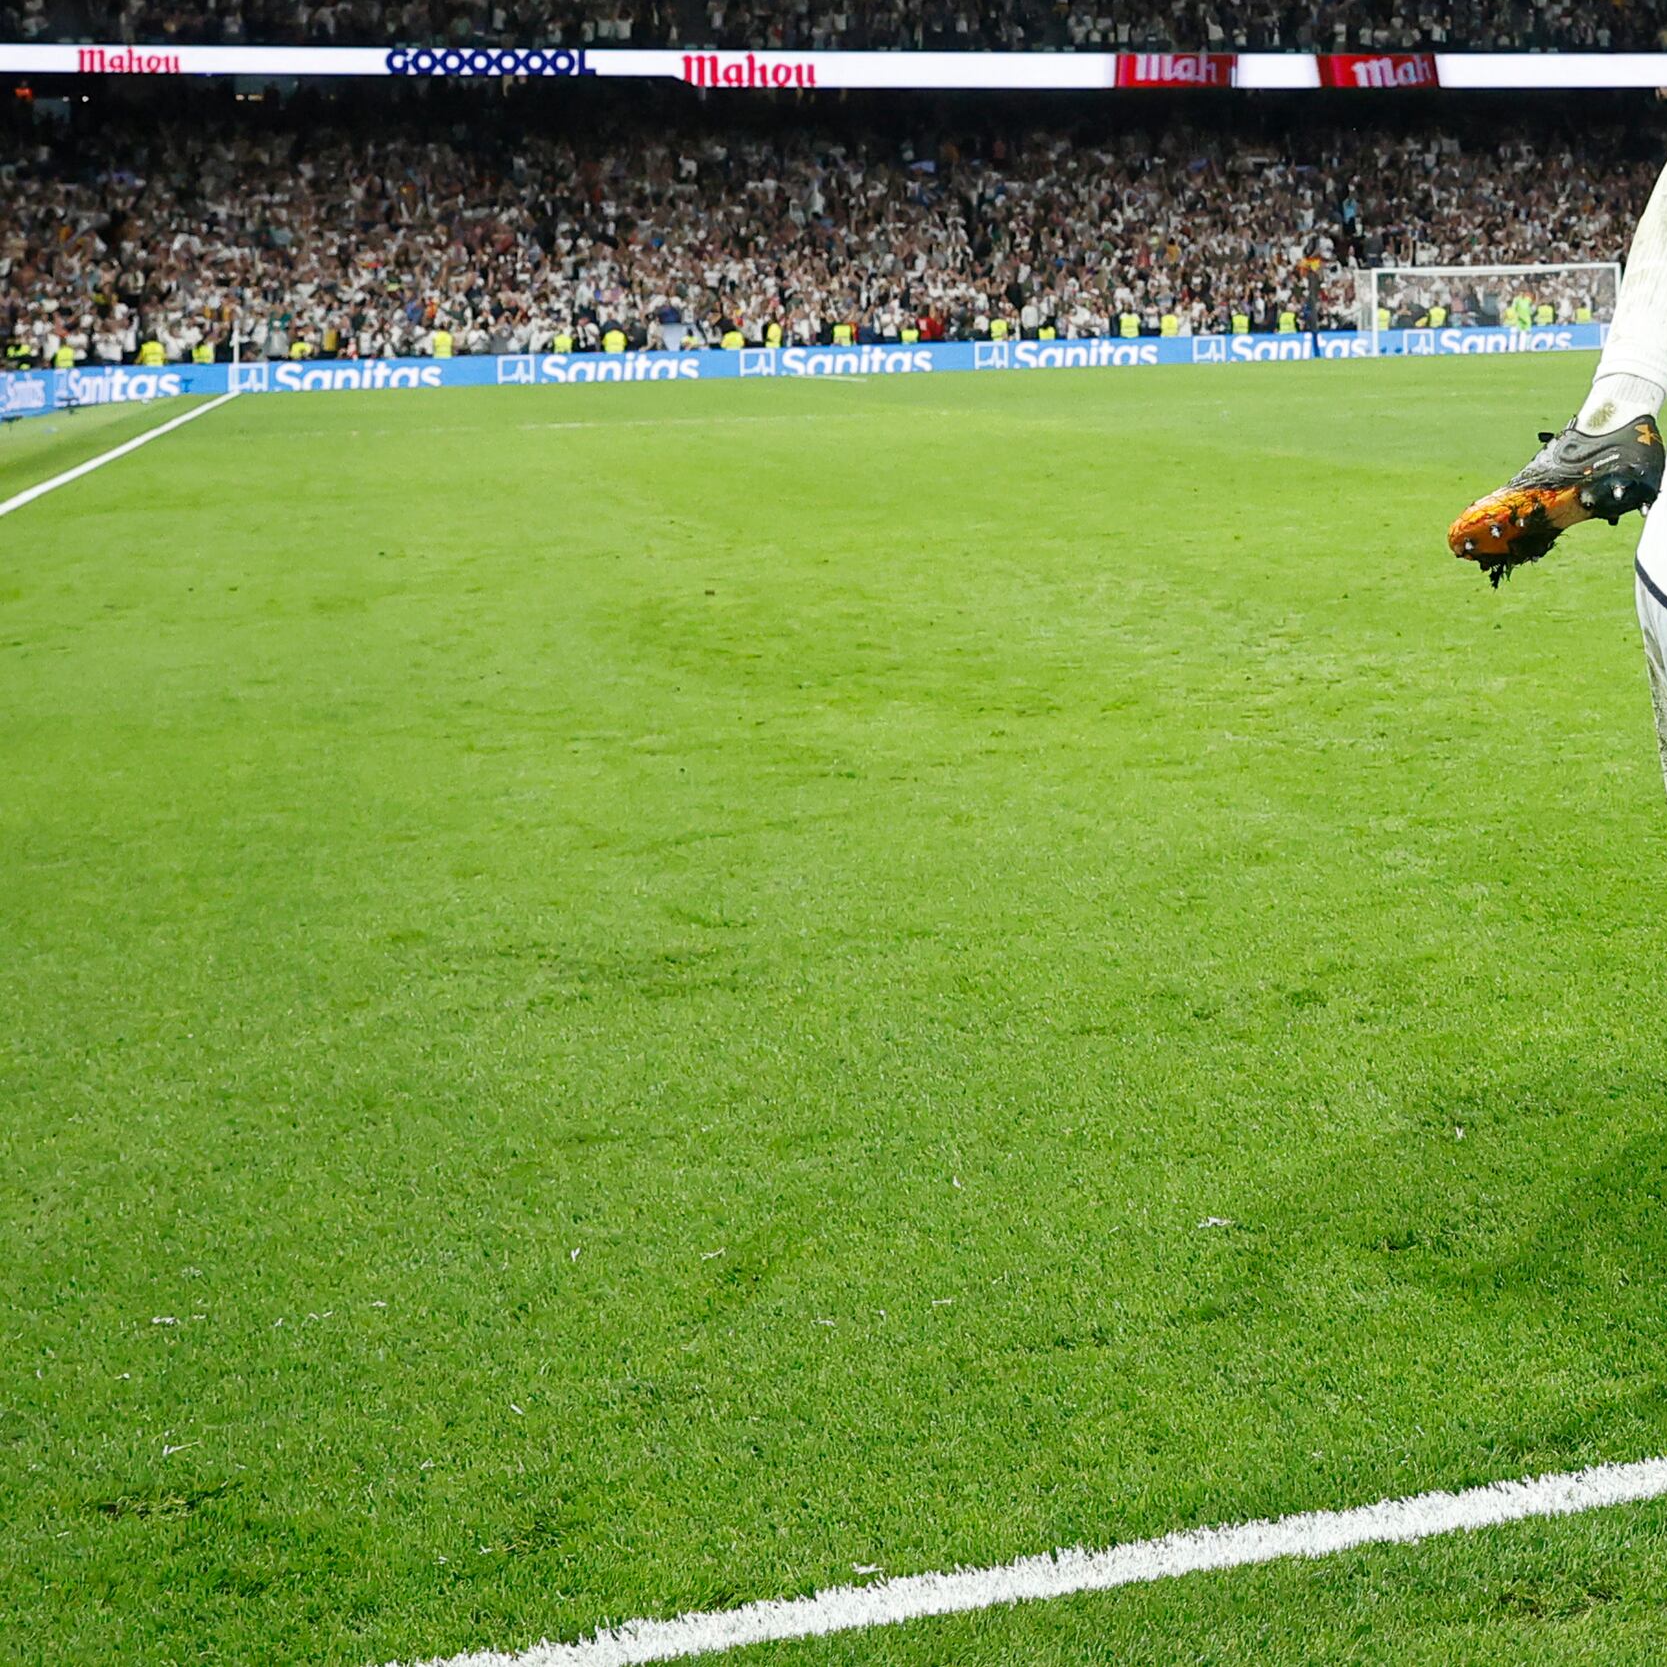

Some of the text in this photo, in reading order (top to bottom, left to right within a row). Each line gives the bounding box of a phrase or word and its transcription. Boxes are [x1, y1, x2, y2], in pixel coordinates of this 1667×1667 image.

[78, 48, 180, 74] Mahou
[385, 49, 596, 76] GOOOOOOL
[682, 53, 817, 88] Mahou
[1135, 54, 1218, 83] Mah
[1351, 54, 1432, 88] Mah
[541, 351, 701, 383] Sanitas
[780, 344, 933, 376] Sanitas
[1013, 338, 1158, 368] Sanitas
[68, 367, 181, 406] Sanitas
[275, 360, 443, 392] Sanitas
